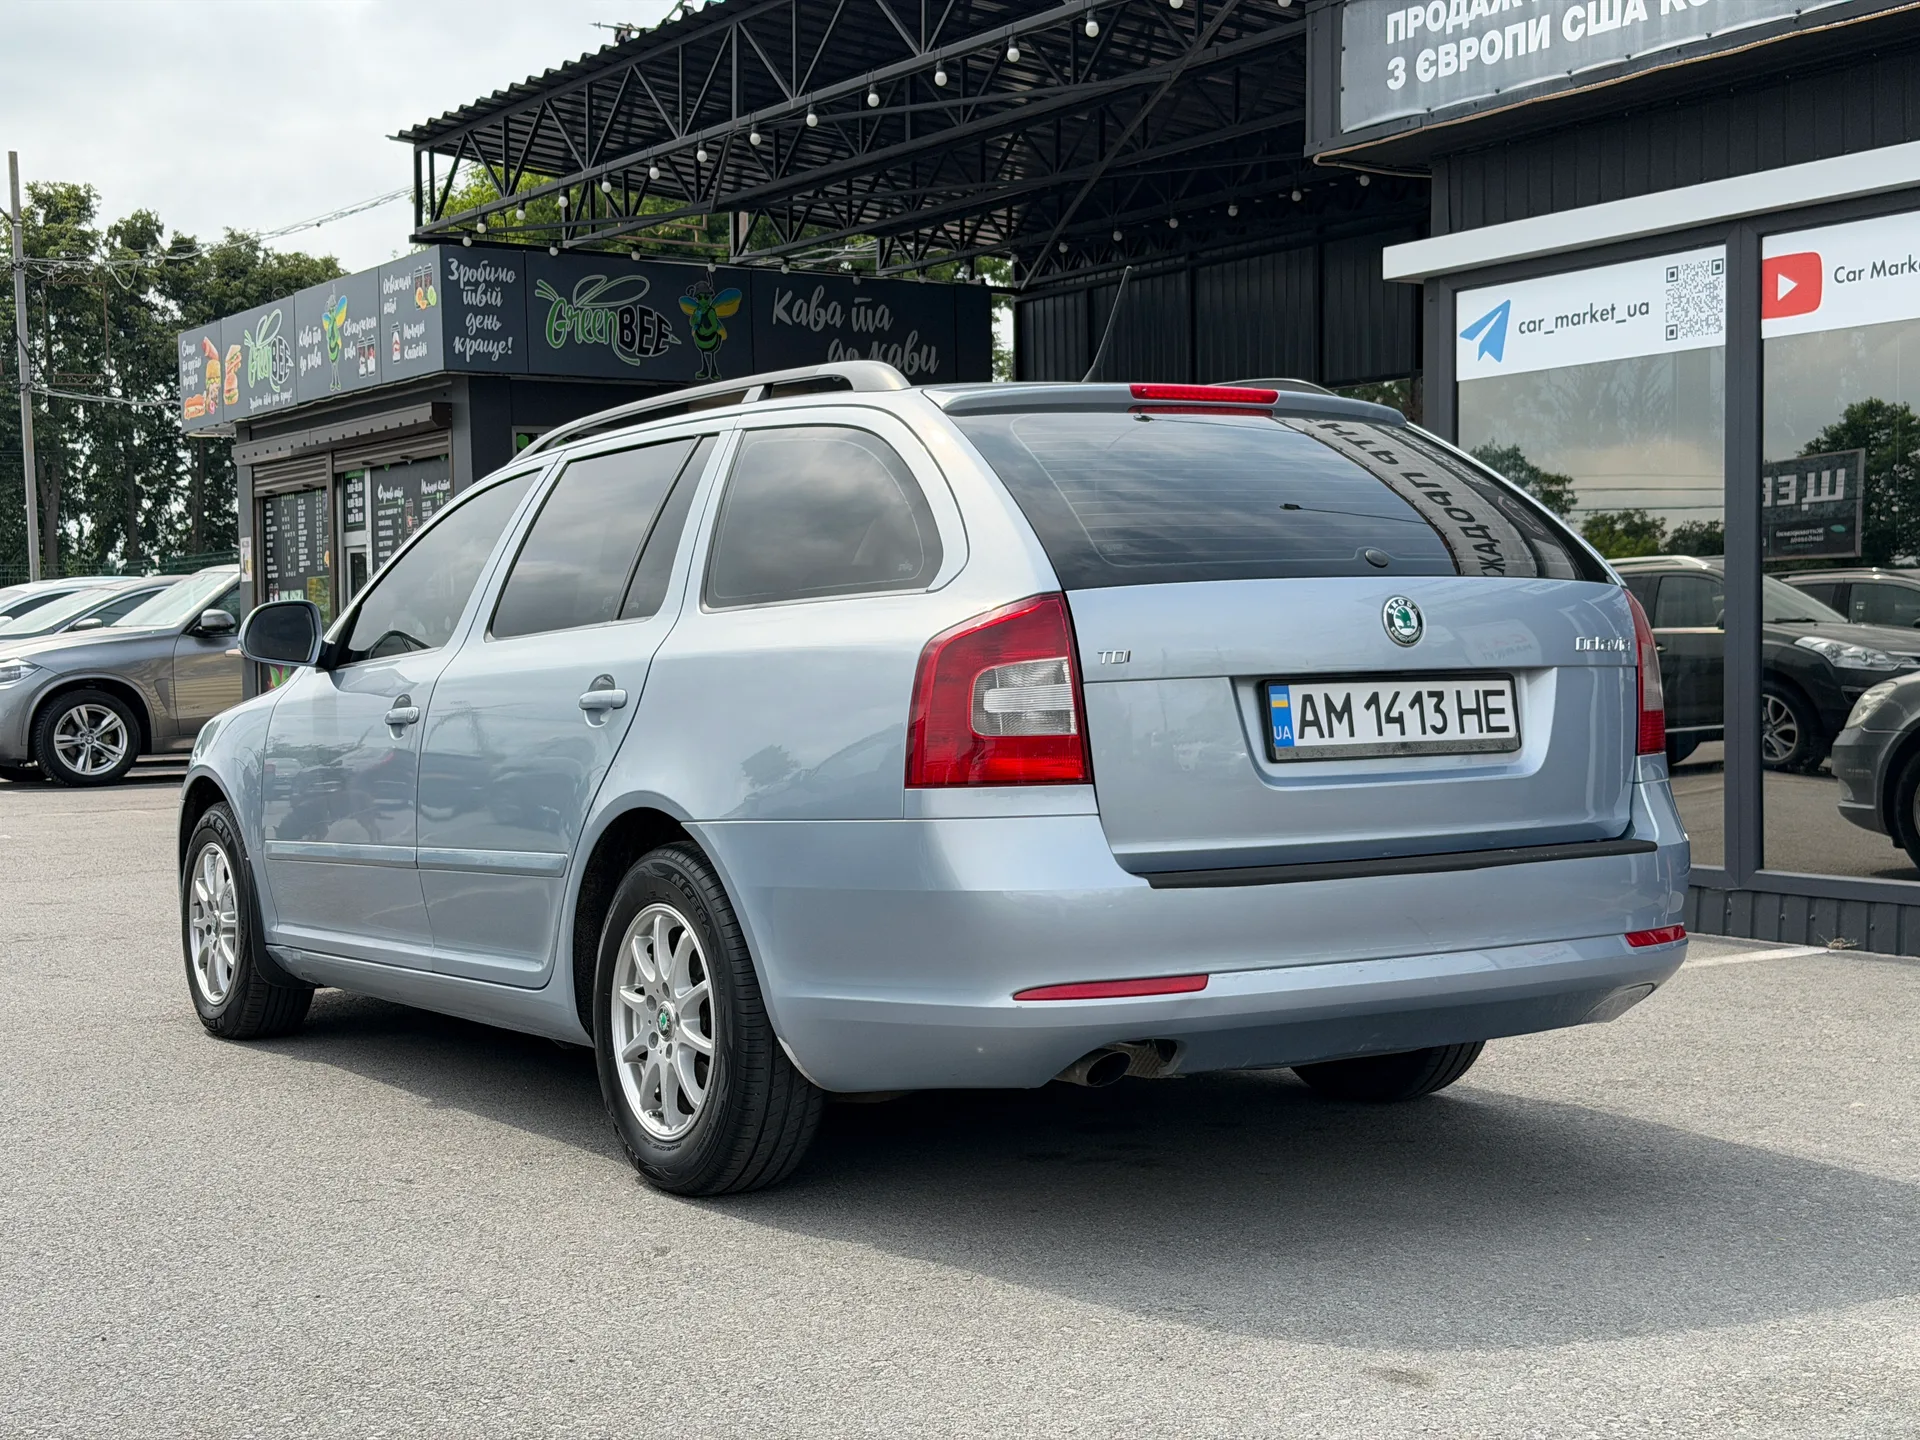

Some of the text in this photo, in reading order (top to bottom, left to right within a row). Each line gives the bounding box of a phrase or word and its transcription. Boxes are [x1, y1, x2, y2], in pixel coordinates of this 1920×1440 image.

[1386, 0, 1648, 91] З ЄВРОПИ США
[448, 258, 516, 289] Зробимо
[1834, 254, 1920, 284] Car Mark
[463, 283, 503, 307] твій
[772, 285, 893, 333] Кава та
[466, 312, 502, 336] день
[1518, 301, 1649, 334] car_market_ua
[453, 336, 513, 363] краще!
[1097, 650, 1131, 665] TDI
[1298, 689, 1510, 739] AM 1413 HE
[1273, 725, 1292, 740] UA
